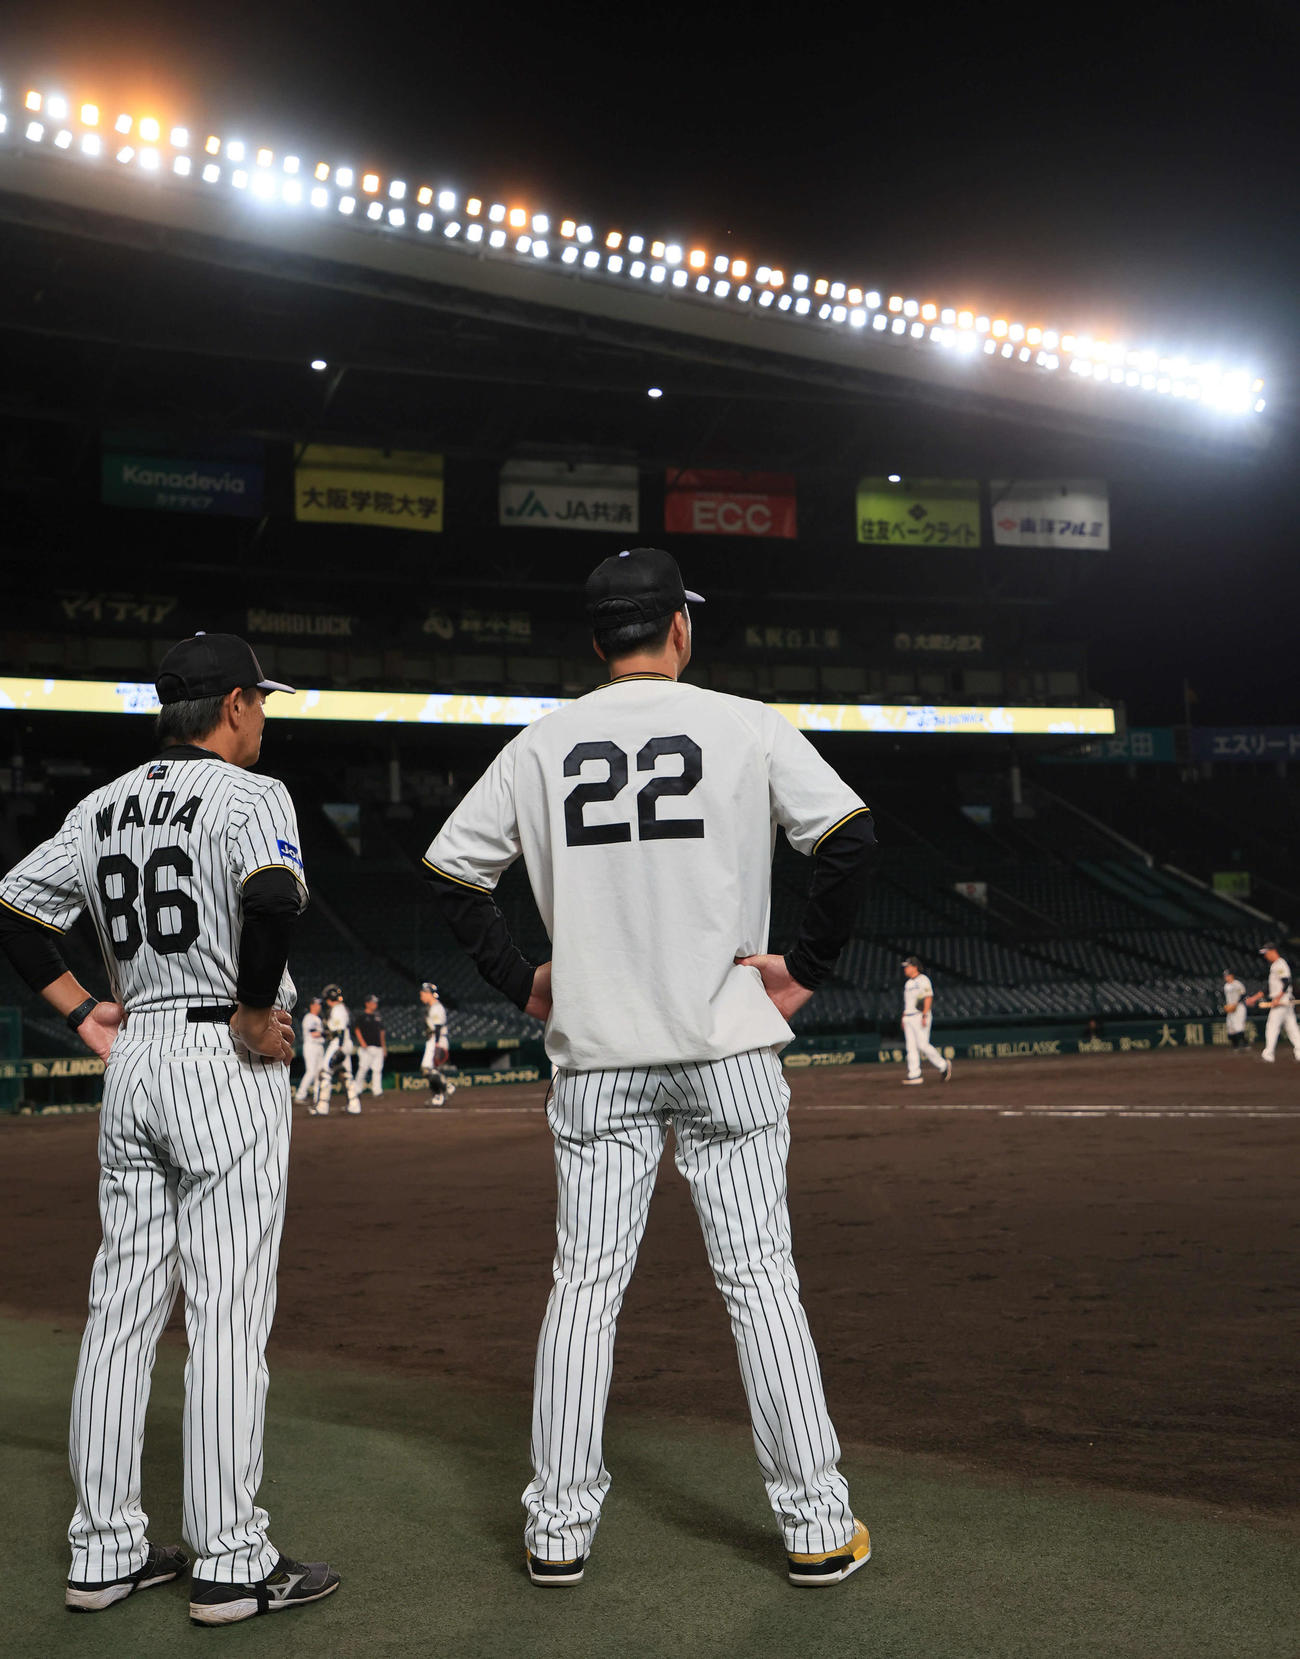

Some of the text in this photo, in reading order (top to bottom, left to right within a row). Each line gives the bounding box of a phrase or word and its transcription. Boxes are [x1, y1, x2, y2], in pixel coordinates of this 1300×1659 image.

[122, 464, 245, 494] Kanadevia
[303, 486, 438, 518] 大阪学院大学
[555, 500, 633, 523] JA共済
[693, 501, 772, 534] ECC
[862, 519, 976, 543] 住友ベークライト
[563, 735, 705, 847] 22
[95, 791, 203, 842] WADA
[97, 845, 200, 961] 86
